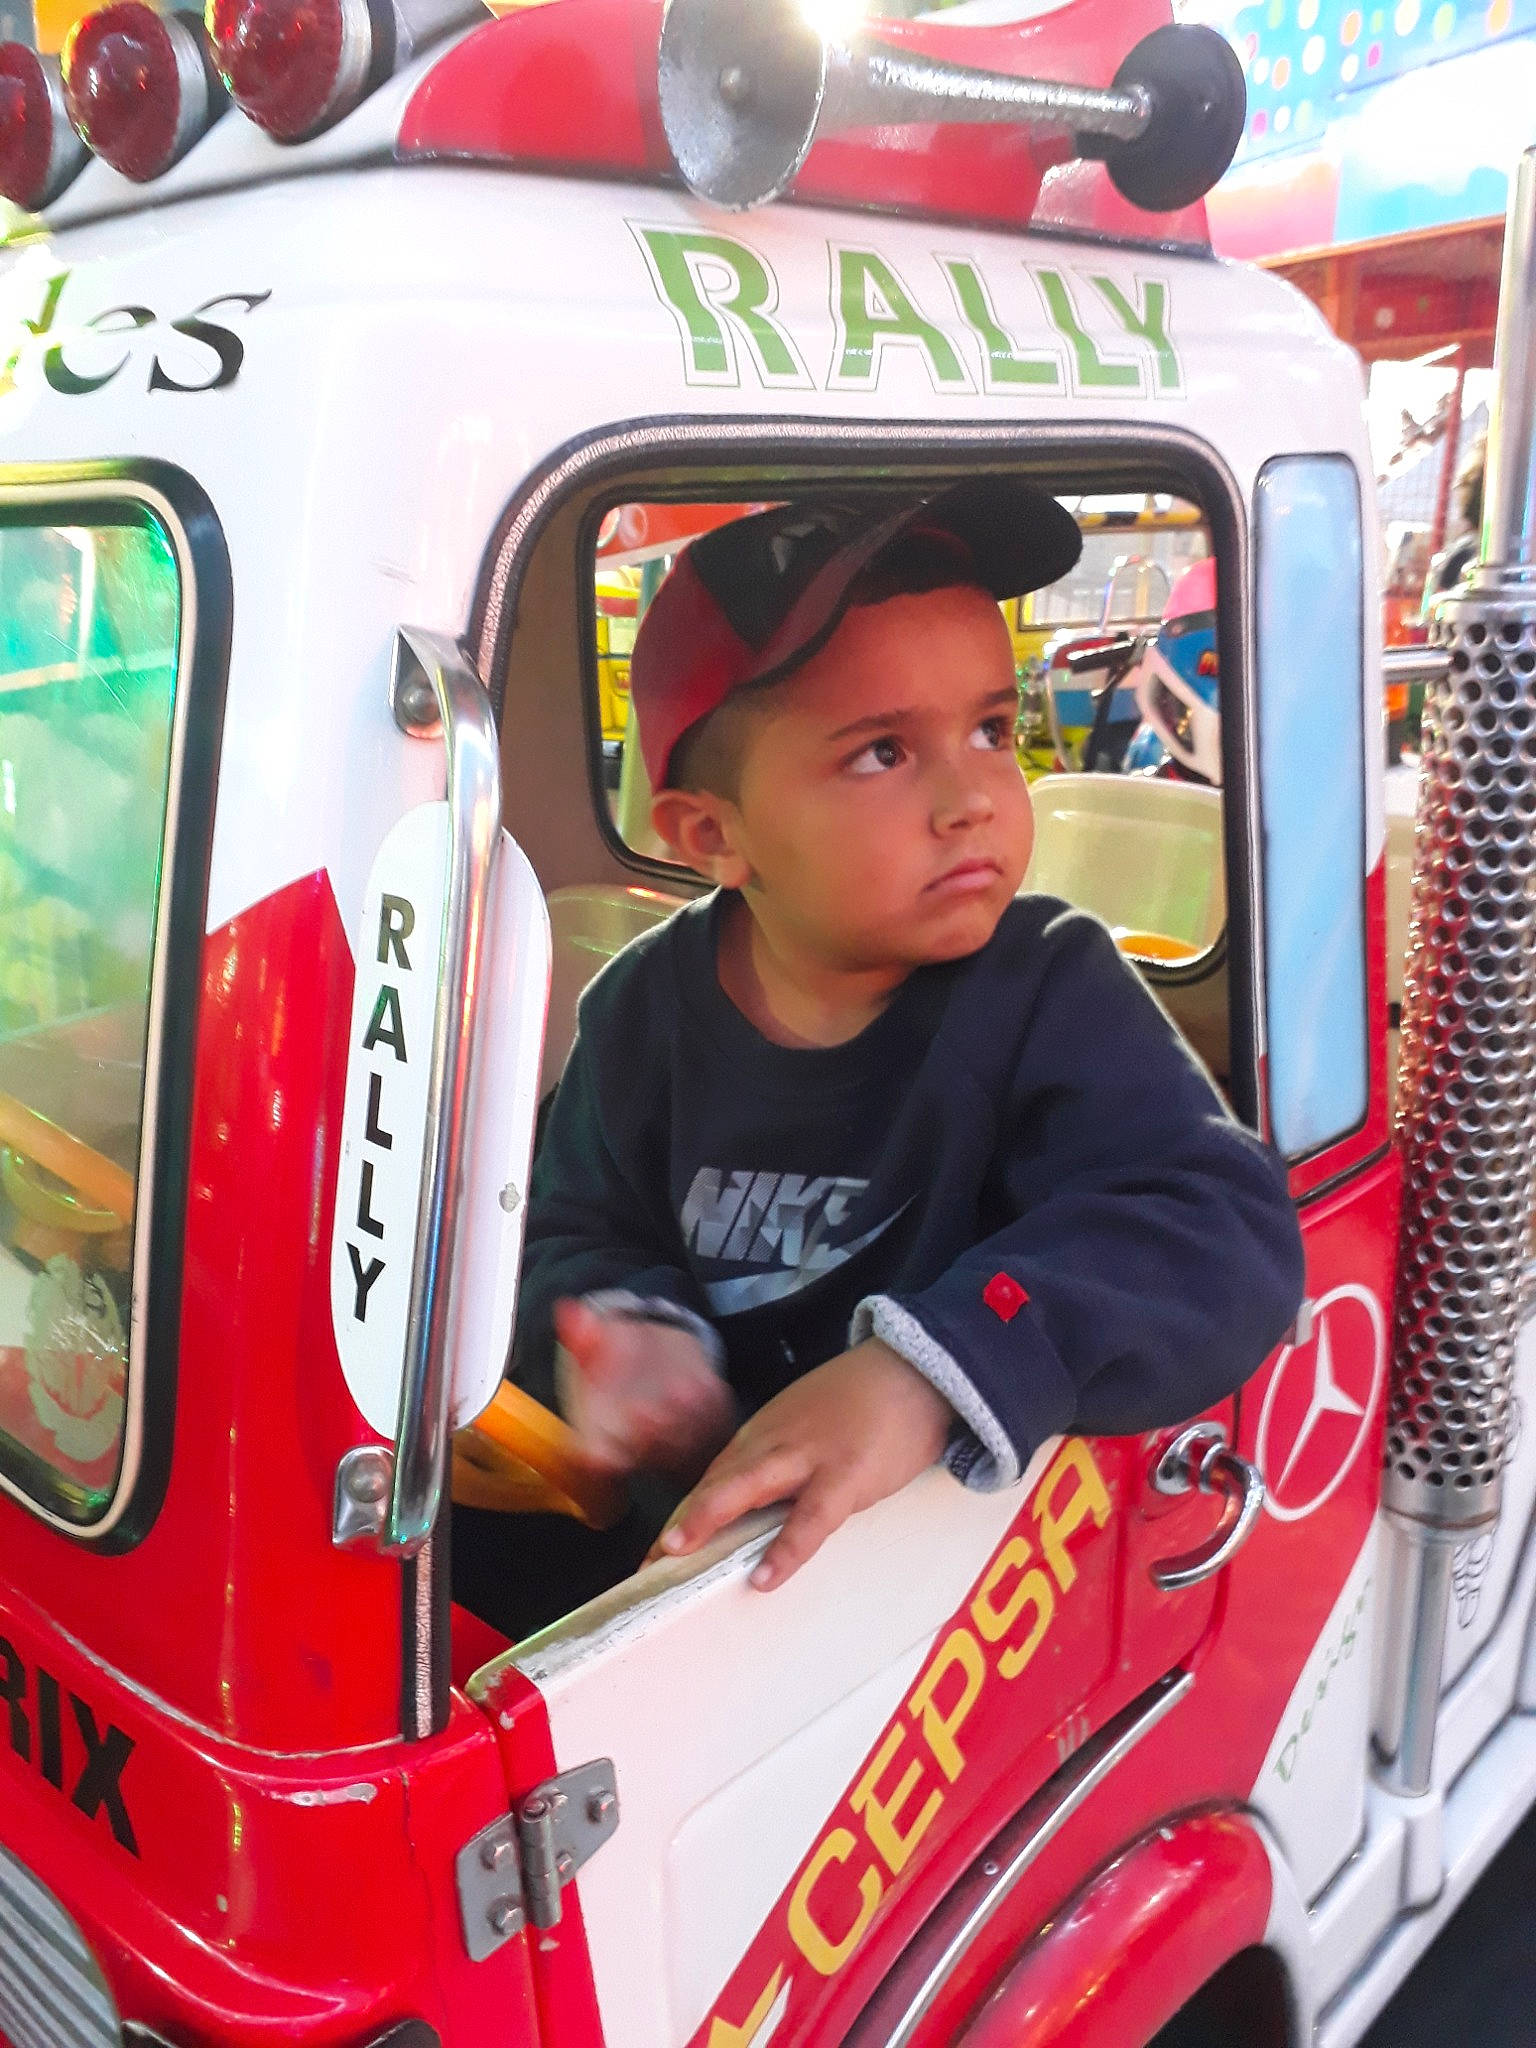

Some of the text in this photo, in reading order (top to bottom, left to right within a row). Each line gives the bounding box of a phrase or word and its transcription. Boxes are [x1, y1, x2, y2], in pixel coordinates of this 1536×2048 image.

[624, 218, 1187, 399] RALLY
[346, 892, 415, 1323] RALLY
[680, 1166, 870, 1270] NIKE
[788, 1438, 1111, 1976] CEPSA
